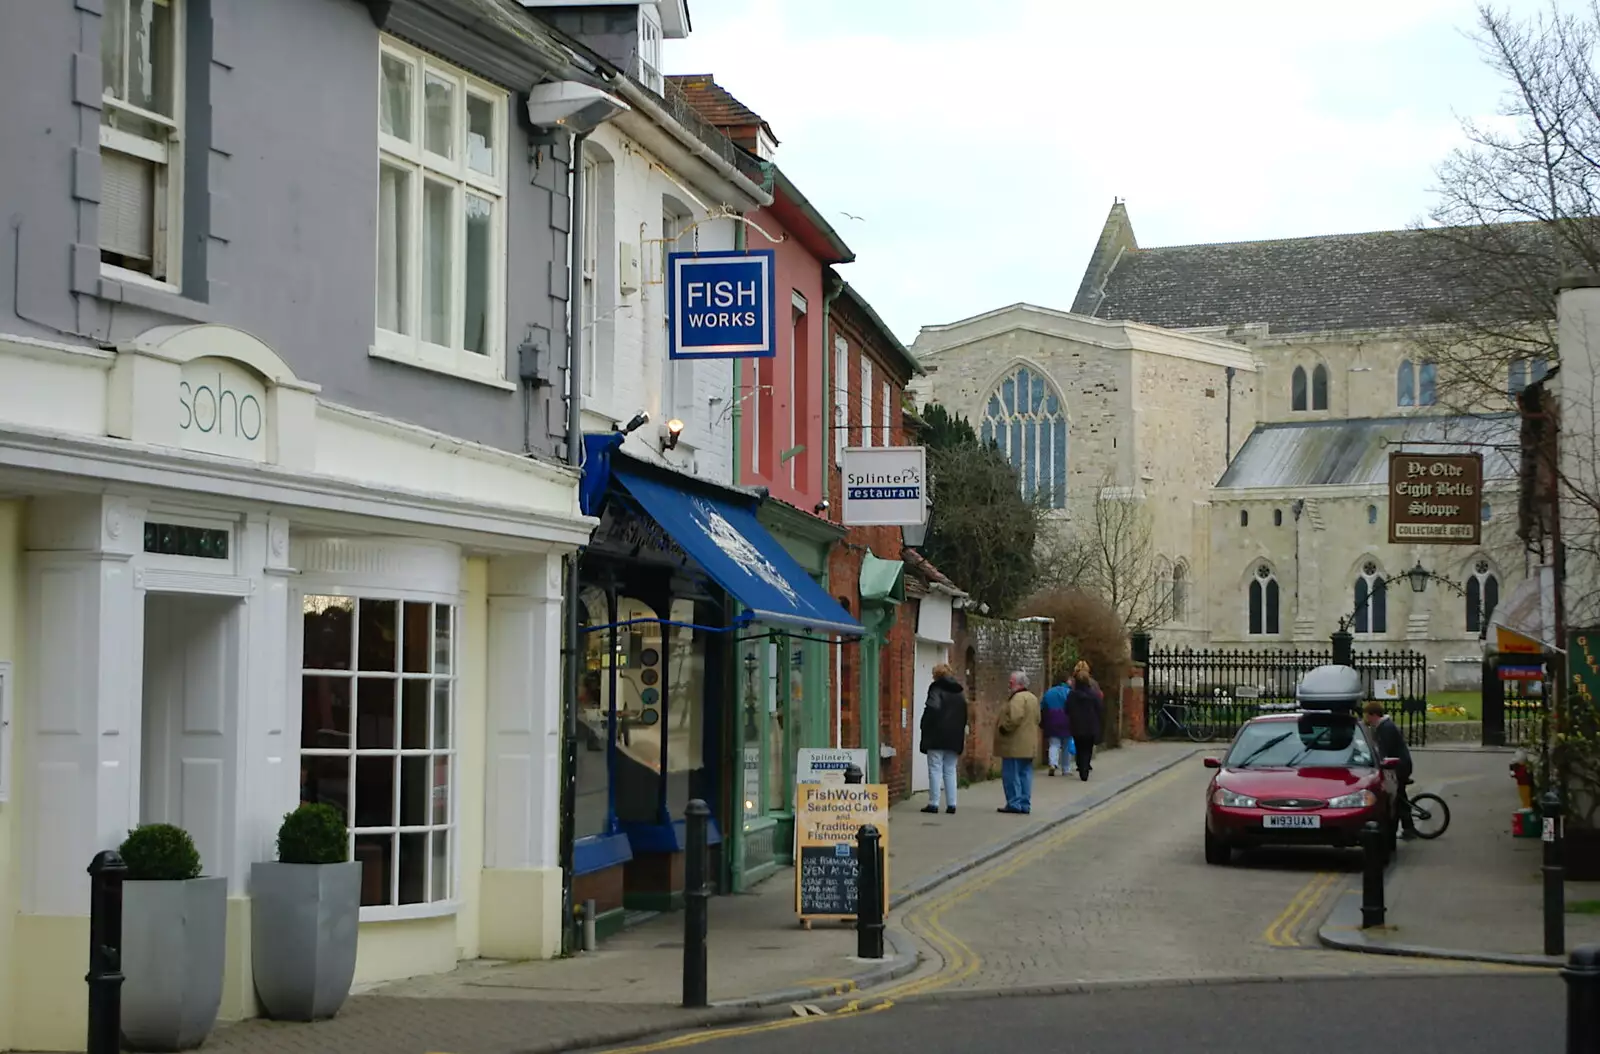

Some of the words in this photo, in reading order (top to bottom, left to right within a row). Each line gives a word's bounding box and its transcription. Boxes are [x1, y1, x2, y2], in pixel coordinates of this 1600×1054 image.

[687, 280, 756, 308] FISH
[688, 311, 756, 328] WORKS
[180, 372, 262, 441] soho
[1407, 461, 1427, 478] Ye
[1429, 462, 1464, 477] Olde
[848, 488, 920, 498] restaurant
[1395, 481, 1433, 498] Eight
[1435, 480, 1474, 497] Bells
[1407, 500, 1461, 517] Shoppe
[1576, 636, 1600, 675] GIFT
[807, 789, 879, 801] FishWorks
[808, 802, 851, 812] Seafood
[816, 822, 862, 832] Tradition
[808, 831, 856, 841] Fishmon
